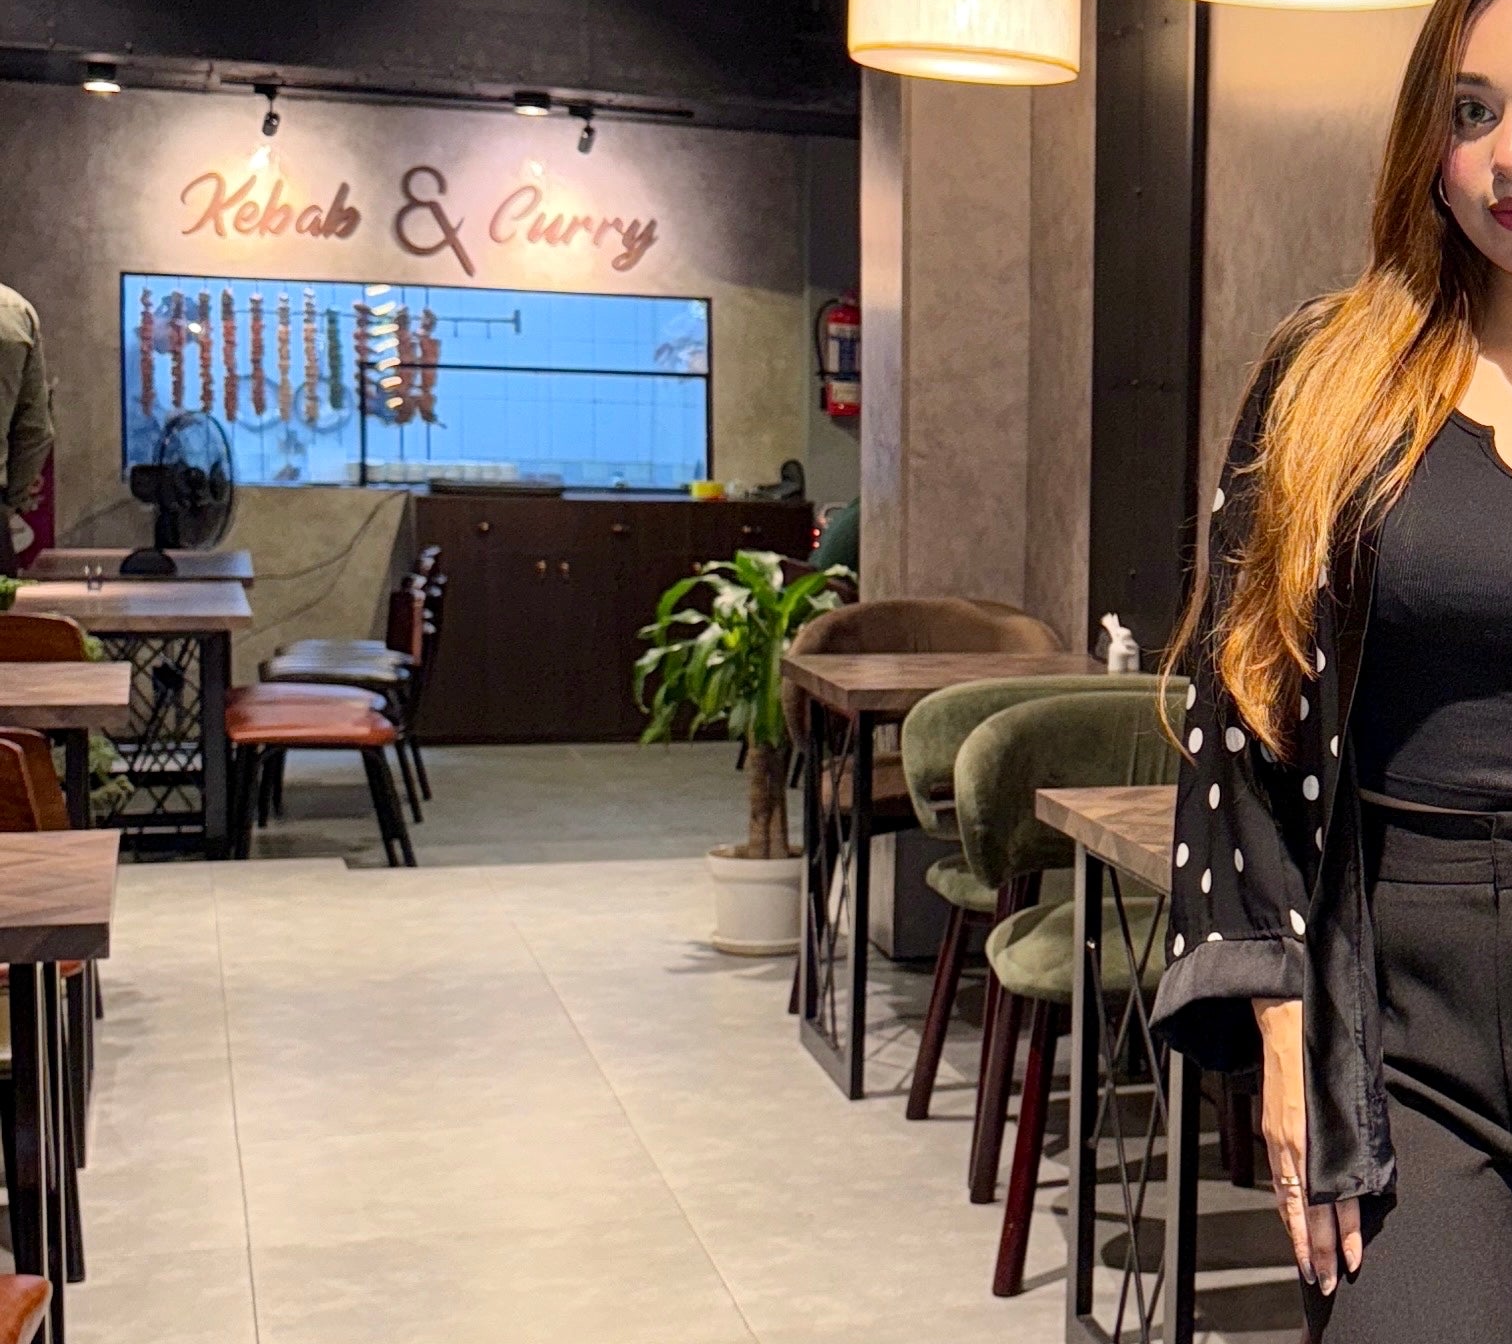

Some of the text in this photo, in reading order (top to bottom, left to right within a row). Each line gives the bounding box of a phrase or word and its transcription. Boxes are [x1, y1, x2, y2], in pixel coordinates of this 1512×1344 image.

[180, 165, 658, 277] Kebab & Curry
